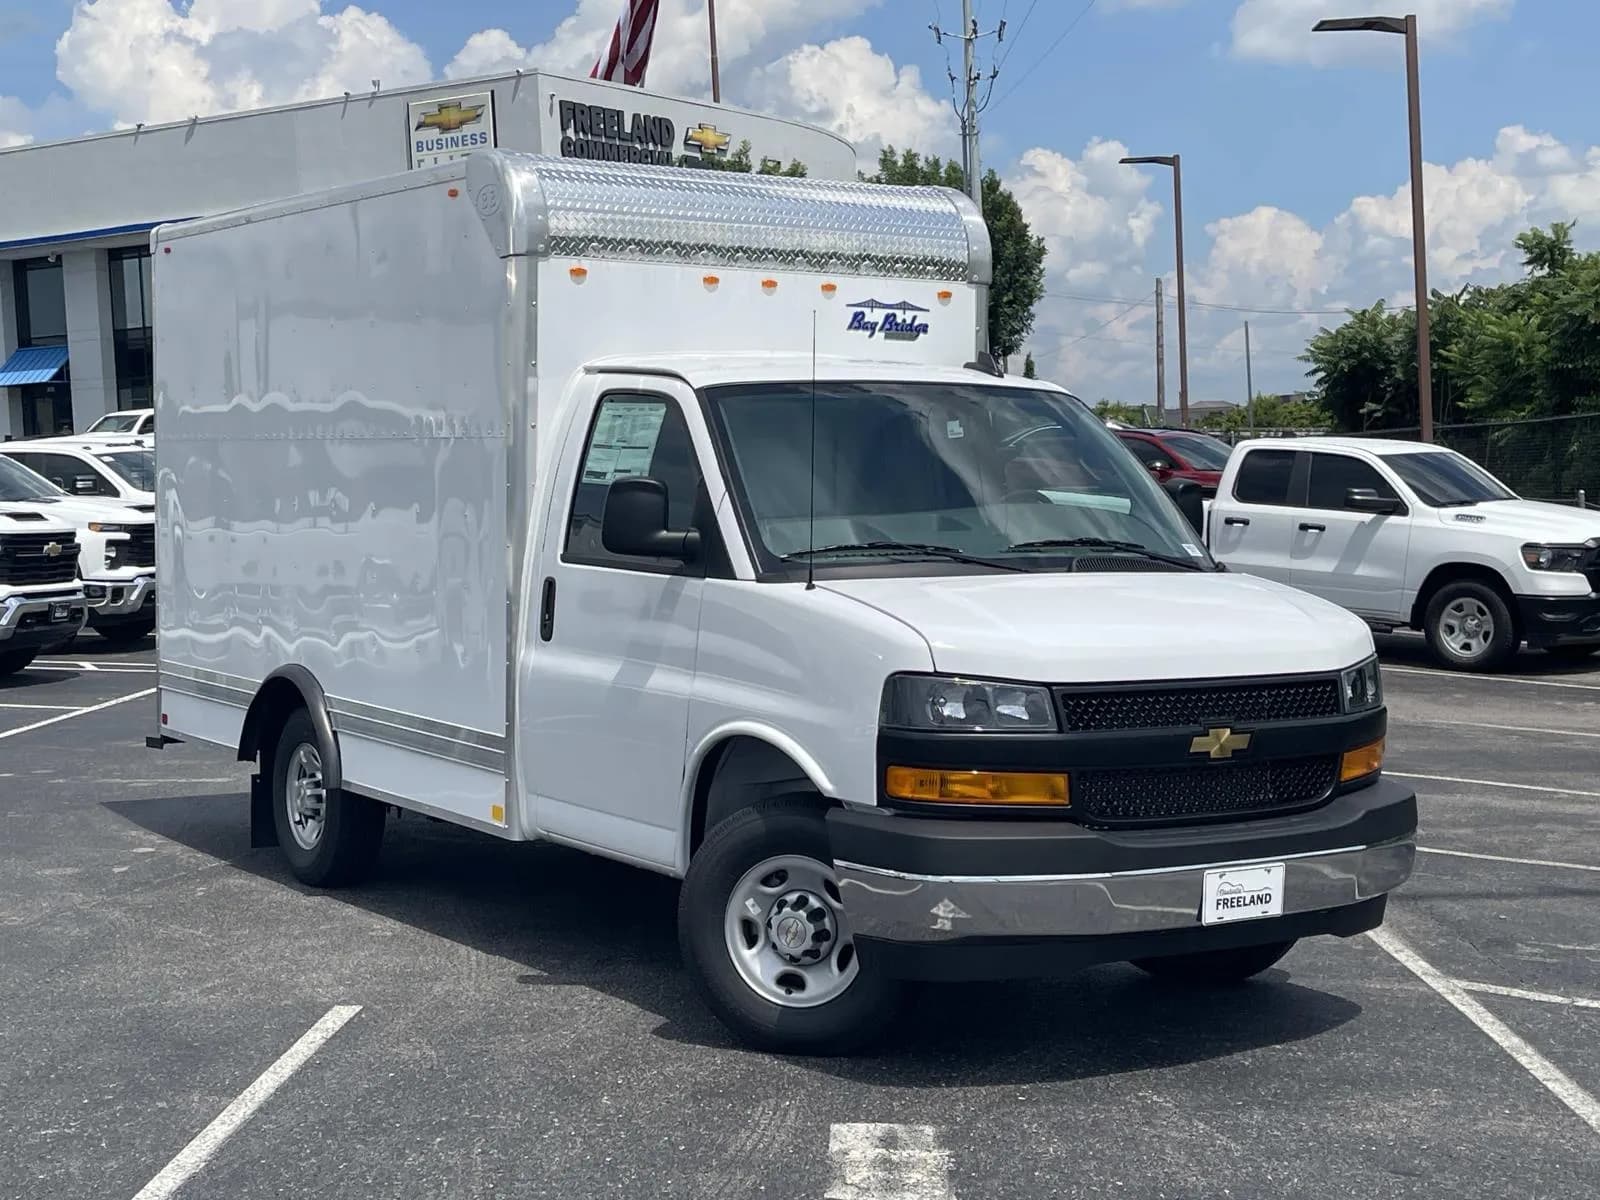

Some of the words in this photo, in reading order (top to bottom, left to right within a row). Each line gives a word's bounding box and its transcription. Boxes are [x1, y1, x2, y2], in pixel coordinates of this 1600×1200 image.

[559, 100, 675, 147] FREELAND
[416, 132, 488, 153] BUSINESS
[846, 311, 879, 339] Bay
[878, 312, 929, 338] Bridge
[1216, 893, 1272, 910] FREELAND
